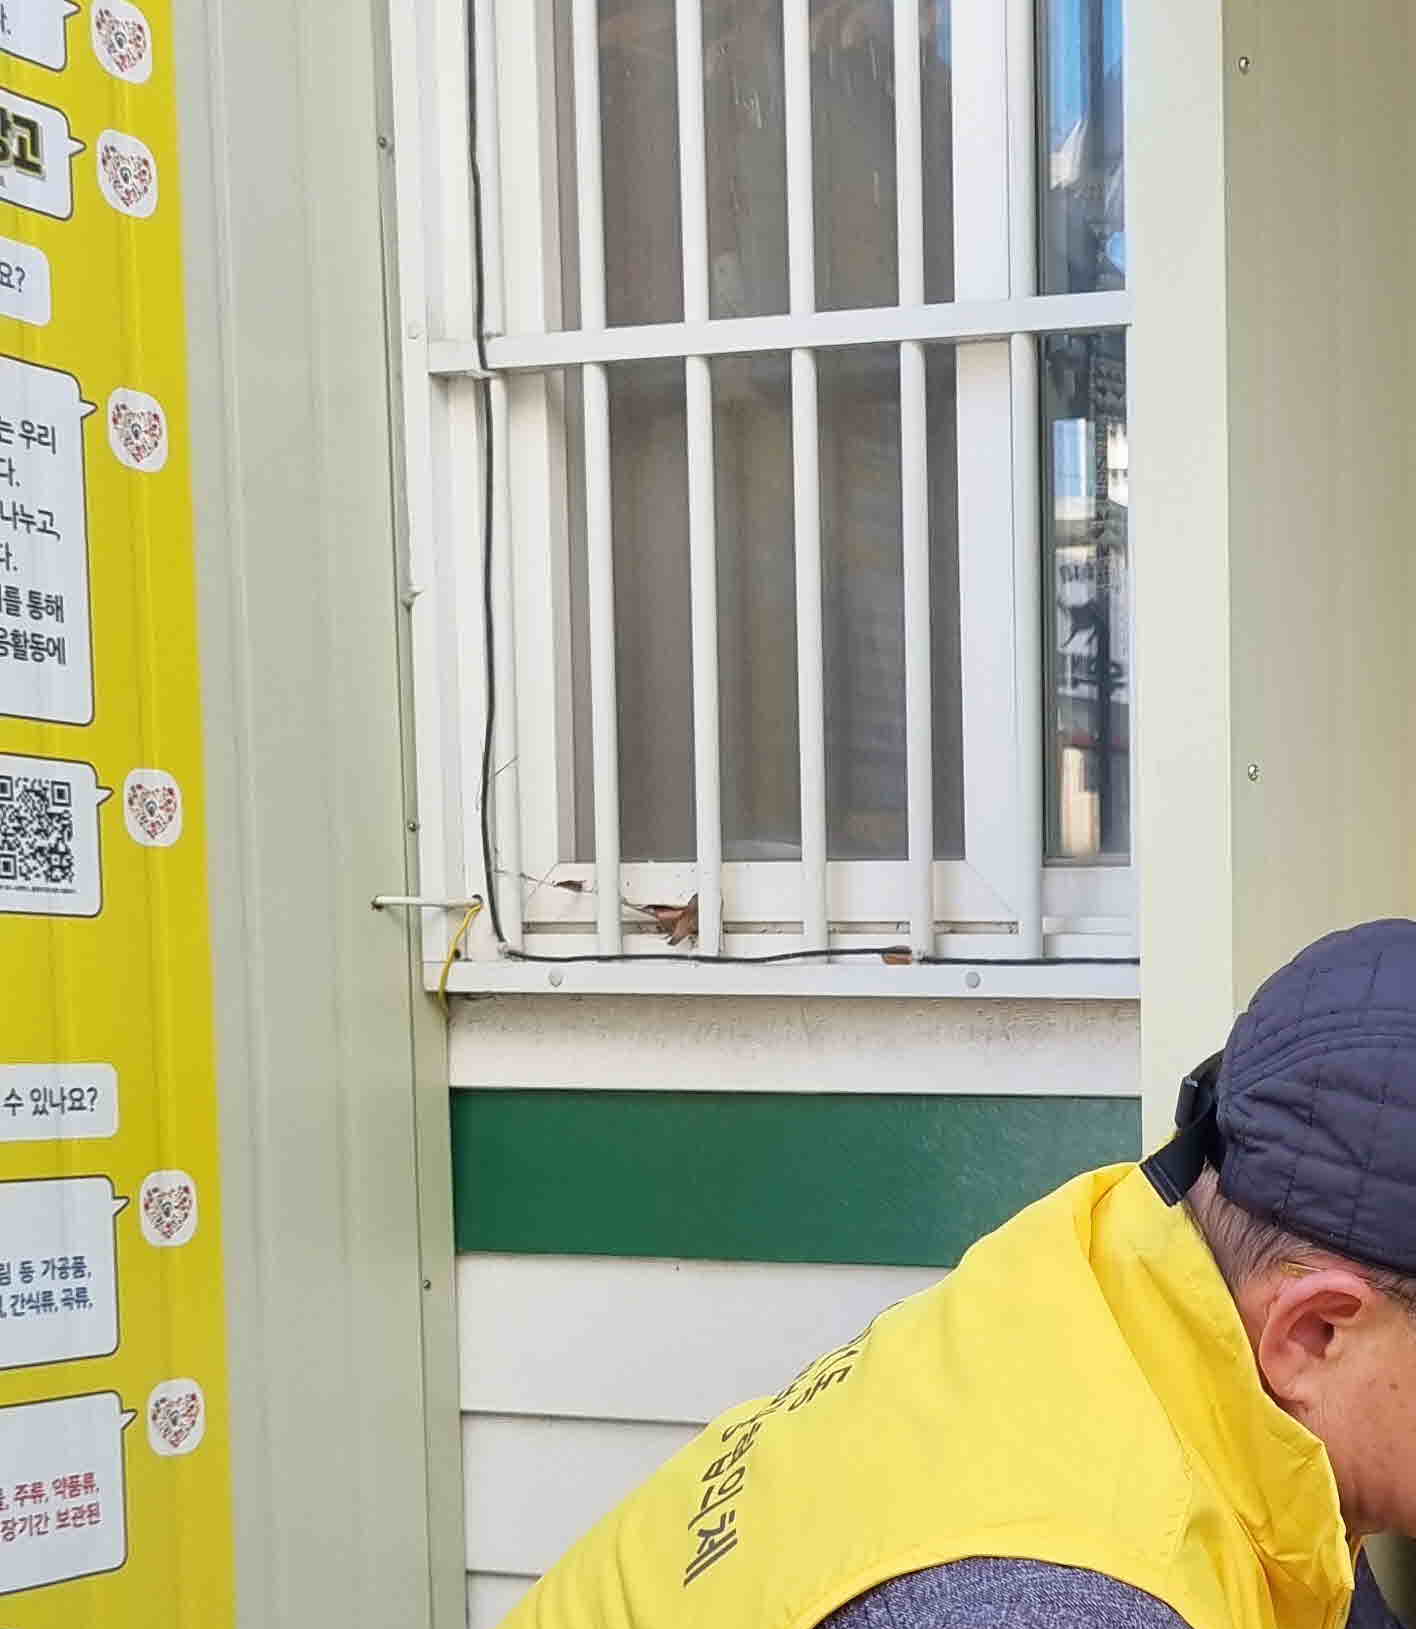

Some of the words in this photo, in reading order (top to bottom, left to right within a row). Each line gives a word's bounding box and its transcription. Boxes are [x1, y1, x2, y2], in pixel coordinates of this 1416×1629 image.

[18, 420, 57, 455] 우리
[0, 499, 62, 542] 나누고
[0, 584, 23, 617] 를
[26, 589, 65, 624] 통해
[3, 1087, 25, 1117] 수
[29, 1084, 99, 1117] 있나요?
[18, 1259, 36, 1284] 등
[40, 1254, 93, 1281] 가공품,
[9, 1290, 59, 1318] 간식류,
[60, 1286, 94, 1312] 곡류,
[13, 1480, 49, 1508] 주류,
[51, 1472, 100, 1500] 약품류,
[0, 1514, 49, 1542] 장기간
[55, 1500, 101, 1530] 보관된
